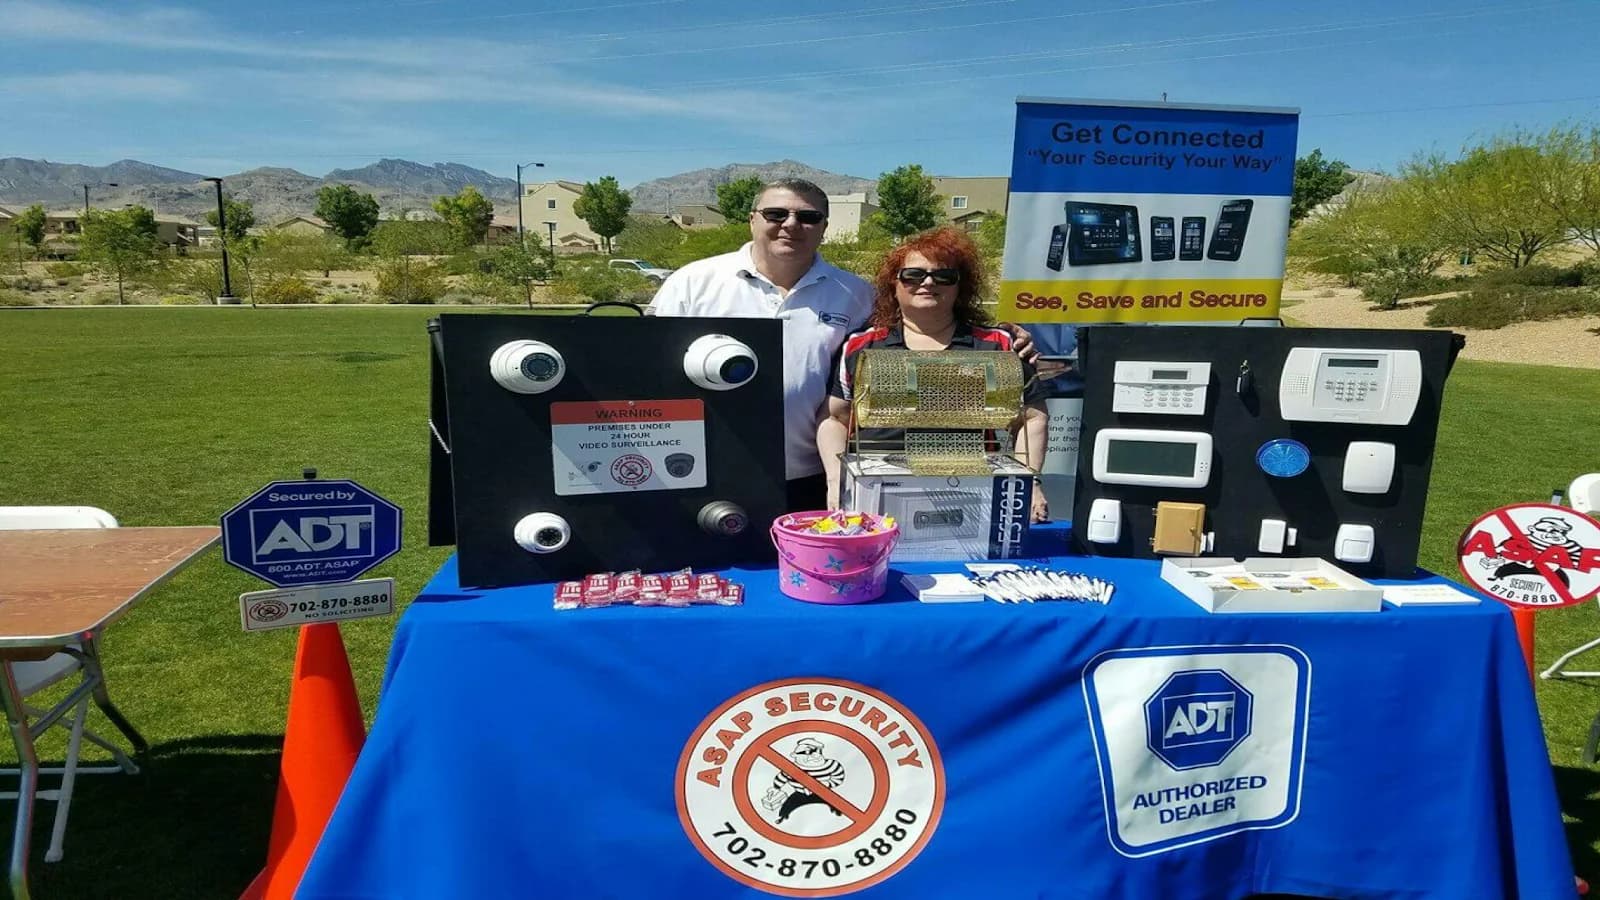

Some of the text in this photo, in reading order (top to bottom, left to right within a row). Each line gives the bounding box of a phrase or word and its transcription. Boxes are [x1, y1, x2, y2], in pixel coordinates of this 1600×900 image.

[1052, 122, 1264, 149] Get Connected
[1093, 151, 1175, 171] Security
[1183, 153, 1227, 169] Your
[1015, 290, 1267, 312] See, Save and Secure
[595, 408, 662, 419] WARNING
[588, 424, 637, 432] PREMISES
[611, 440, 681, 448] SURVEILLANCE
[268, 490, 356, 502] Secured by
[256, 515, 373, 556] ADT
[1490, 584, 1557, 603] 870-8880
[1509, 578, 1545, 593] SECURITY
[290, 593, 388, 613] 702-870-8880
[322, 607, 375, 617] SOLICITING
[1164, 701, 1235, 739] ADT
[697, 691, 923, 788] ASAP SECURITY
[1132, 775, 1268, 810] AUTHORIZED
[1159, 796, 1236, 824] DEALER
[712, 808, 917, 879] 702-870-8880
